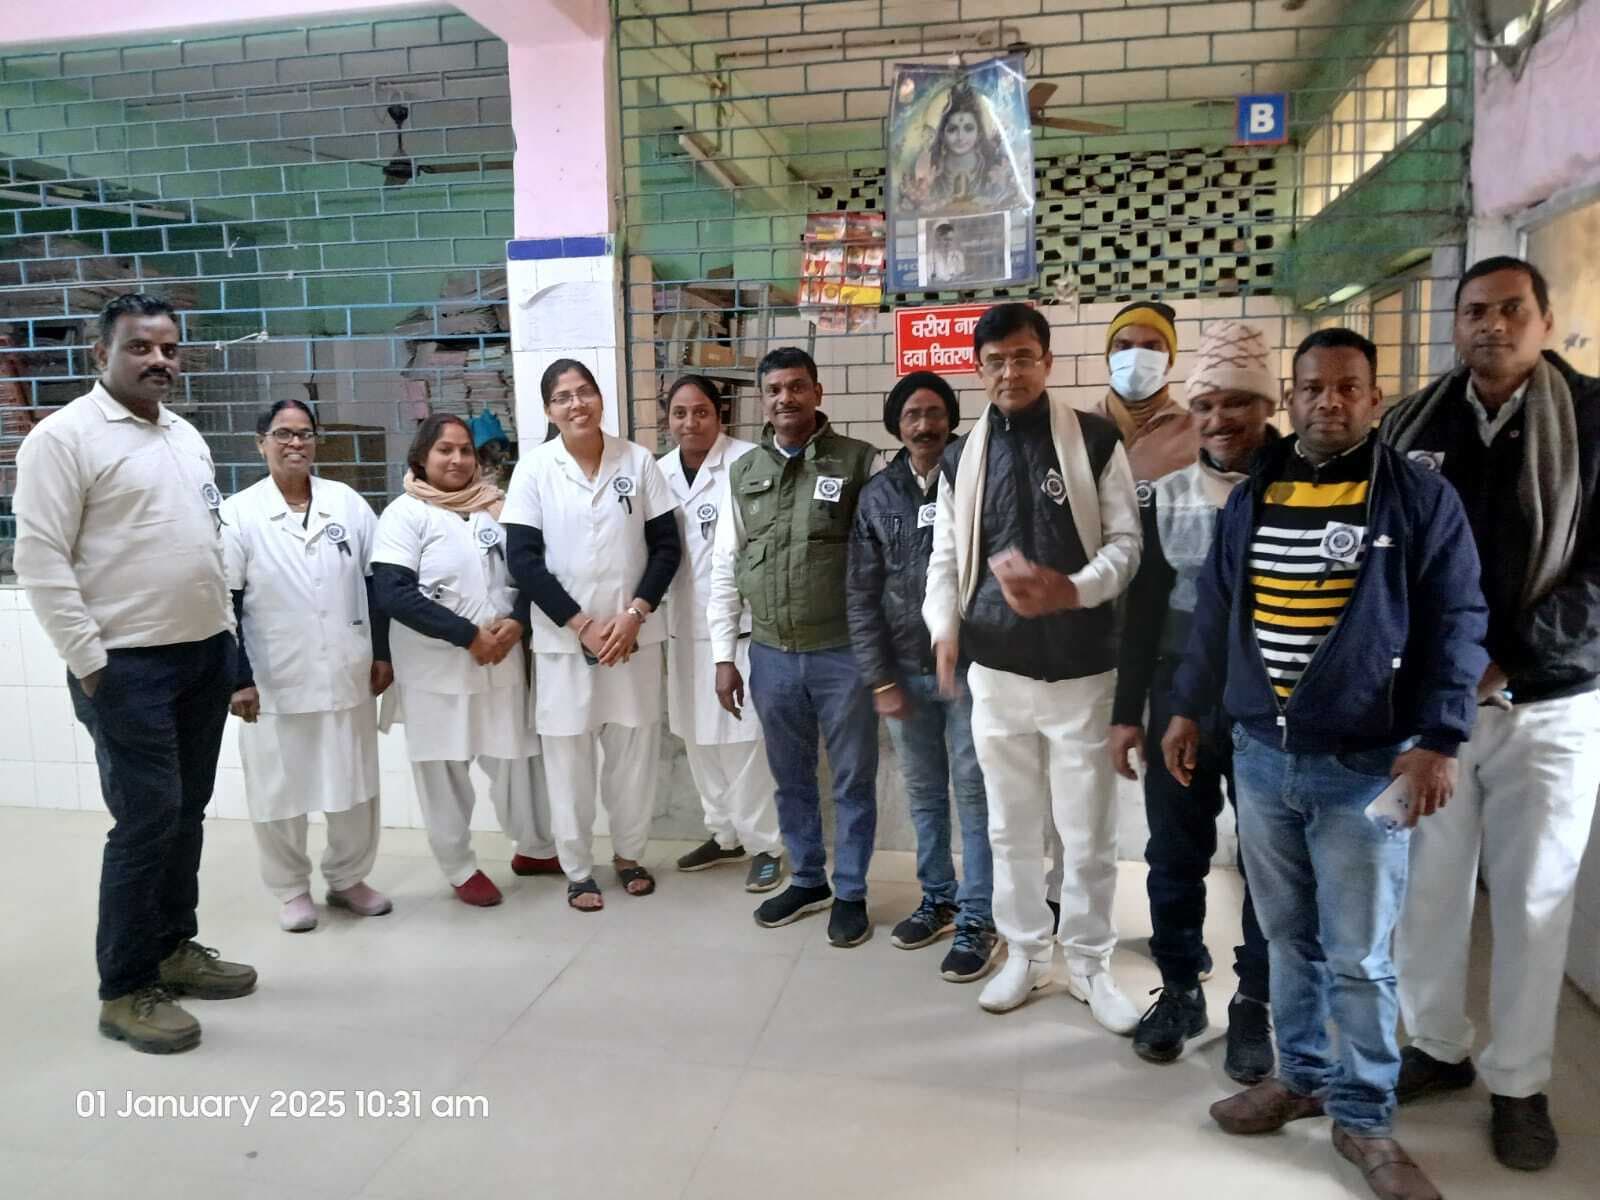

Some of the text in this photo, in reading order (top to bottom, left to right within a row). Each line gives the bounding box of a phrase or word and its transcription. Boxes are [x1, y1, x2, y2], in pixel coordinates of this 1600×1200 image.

[1250, 103, 1274, 133] B
[911, 314, 951, 338] वरीय
[903, 343, 975, 367] दवा वितरण
